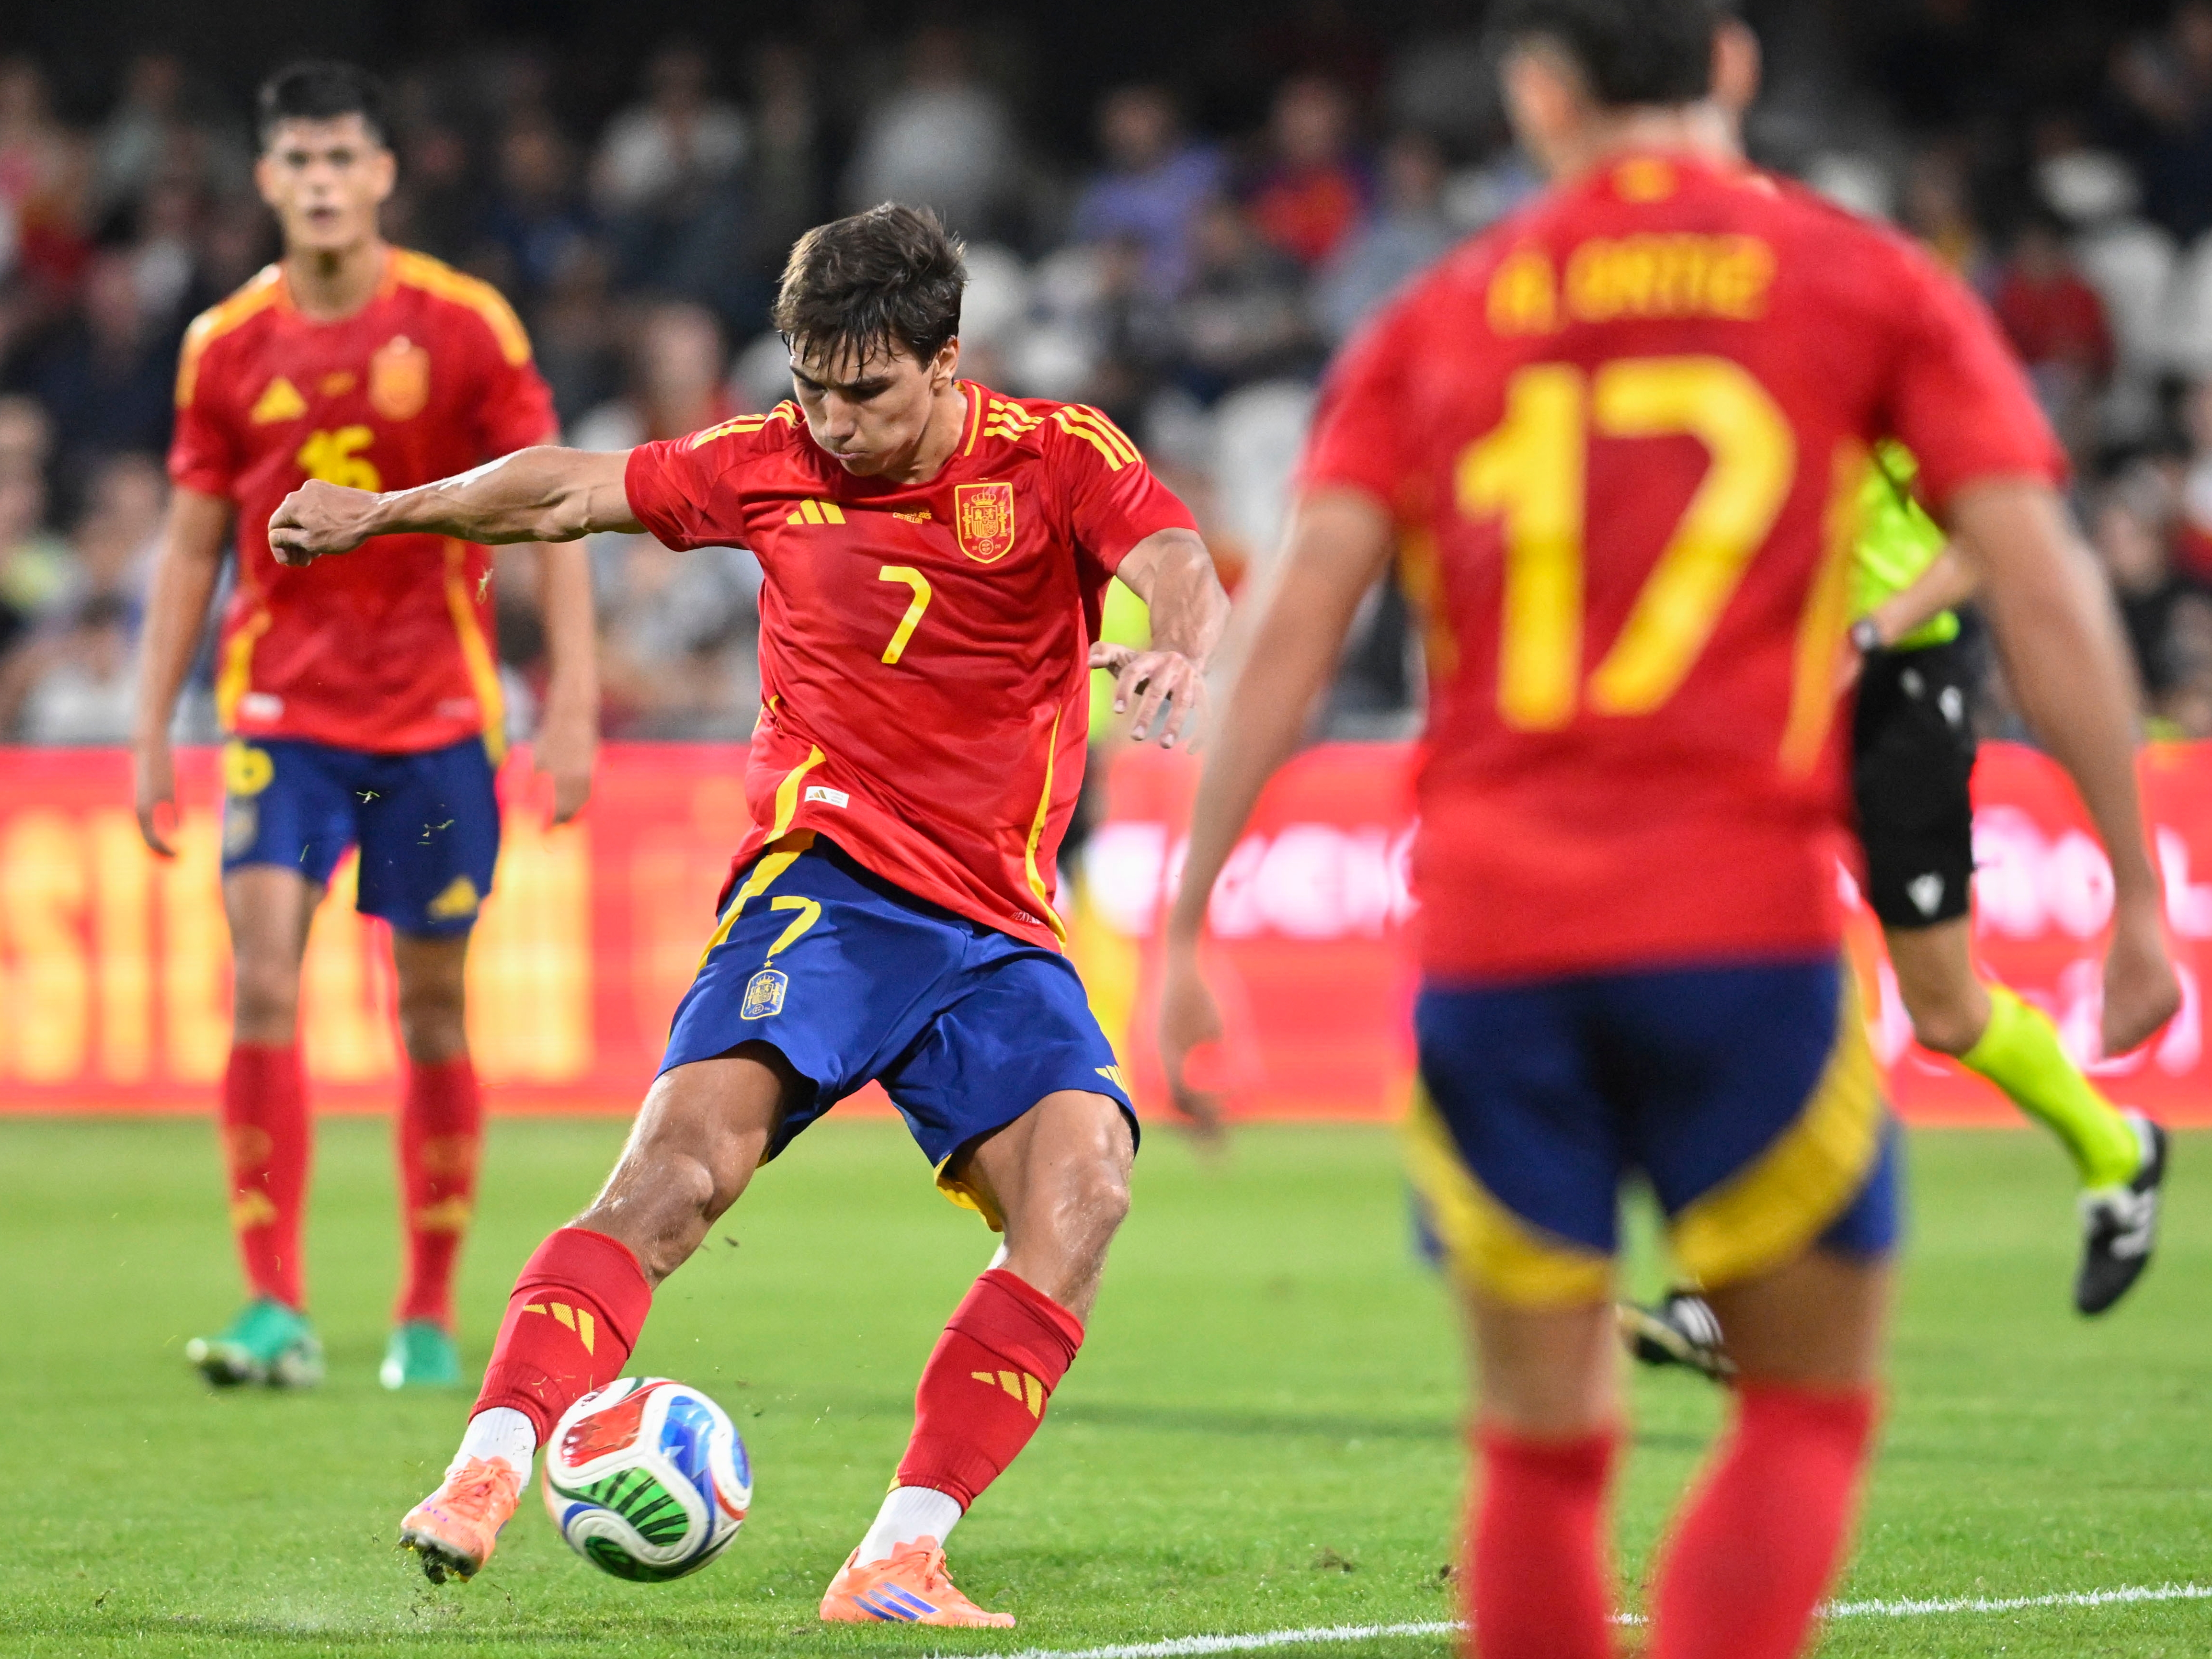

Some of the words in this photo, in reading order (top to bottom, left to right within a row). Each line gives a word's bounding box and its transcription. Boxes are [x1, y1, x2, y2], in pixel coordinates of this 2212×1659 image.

[296, 424, 382, 493] 16
[1457, 357, 1795, 732] 17
[878, 565, 932, 664] 7
[767, 895, 821, 958] 7
